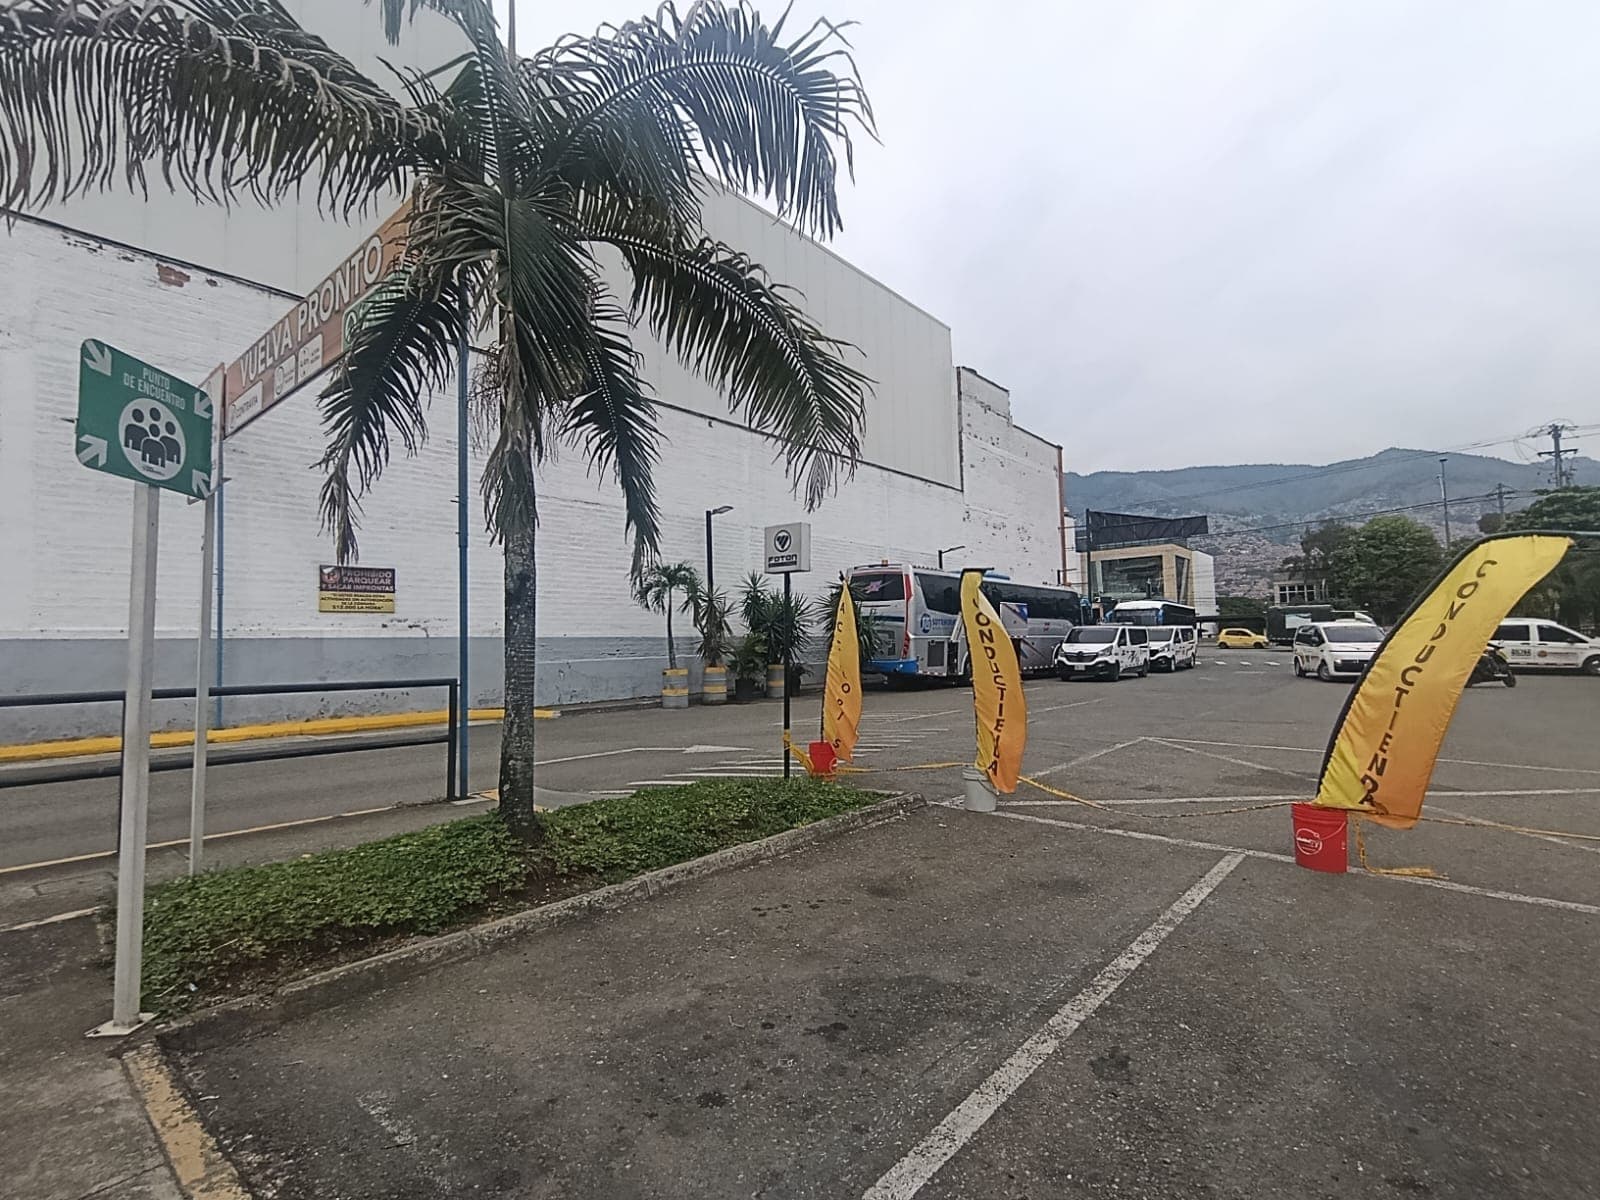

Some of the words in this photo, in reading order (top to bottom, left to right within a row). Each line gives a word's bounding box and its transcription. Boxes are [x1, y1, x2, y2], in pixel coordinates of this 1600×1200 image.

[240, 316, 293, 387] VUELVA
[297, 235, 383, 341] PRONTO
[142, 367, 170, 390] PUNTO
[123, 372, 136, 389] DE
[137, 379, 185, 410] ENCUENTRO
[768, 554, 797, 562] FOTON
[343, 576, 391, 585] PARQUEAR
